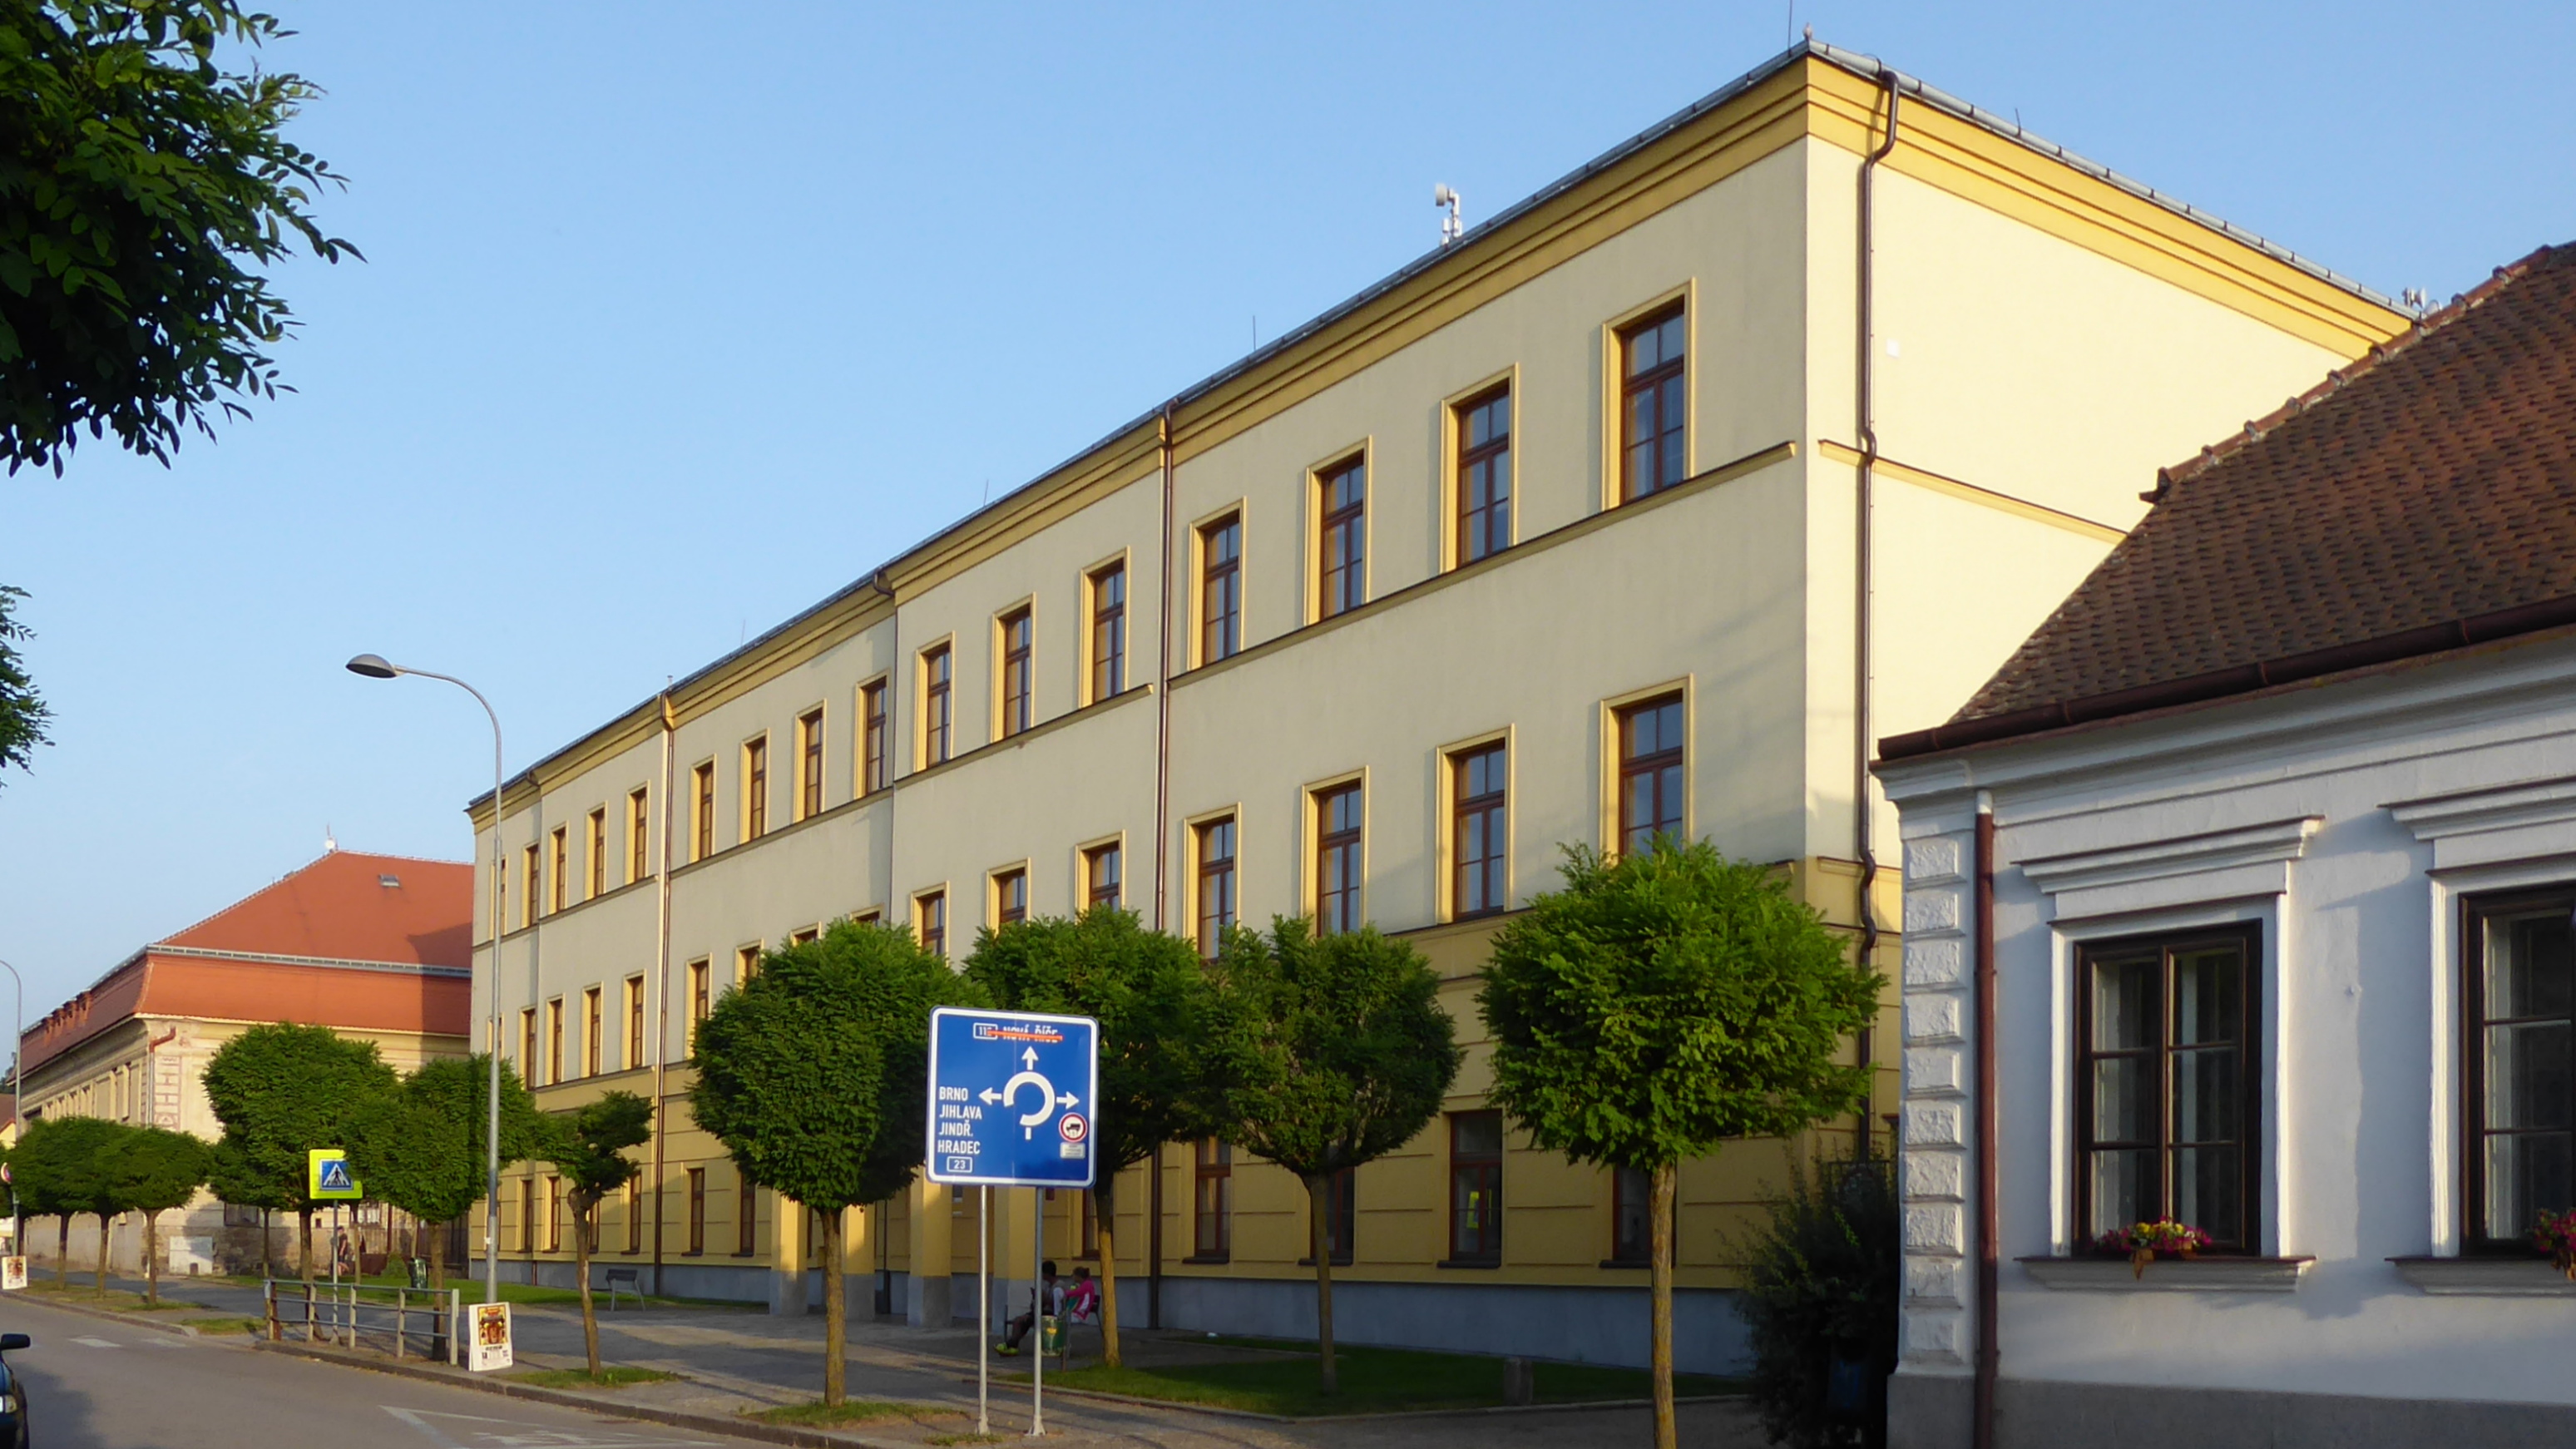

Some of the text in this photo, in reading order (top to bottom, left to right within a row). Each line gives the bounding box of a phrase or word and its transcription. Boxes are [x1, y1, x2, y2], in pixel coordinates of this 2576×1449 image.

[939, 1086, 968, 1101] BRNO
[939, 1104, 982, 1120] JIHLAVA
[938, 1120, 974, 1136] JINDŘ.
[937, 1140, 981, 1155] HRADEC
[953, 1160, 966, 1170] 23
